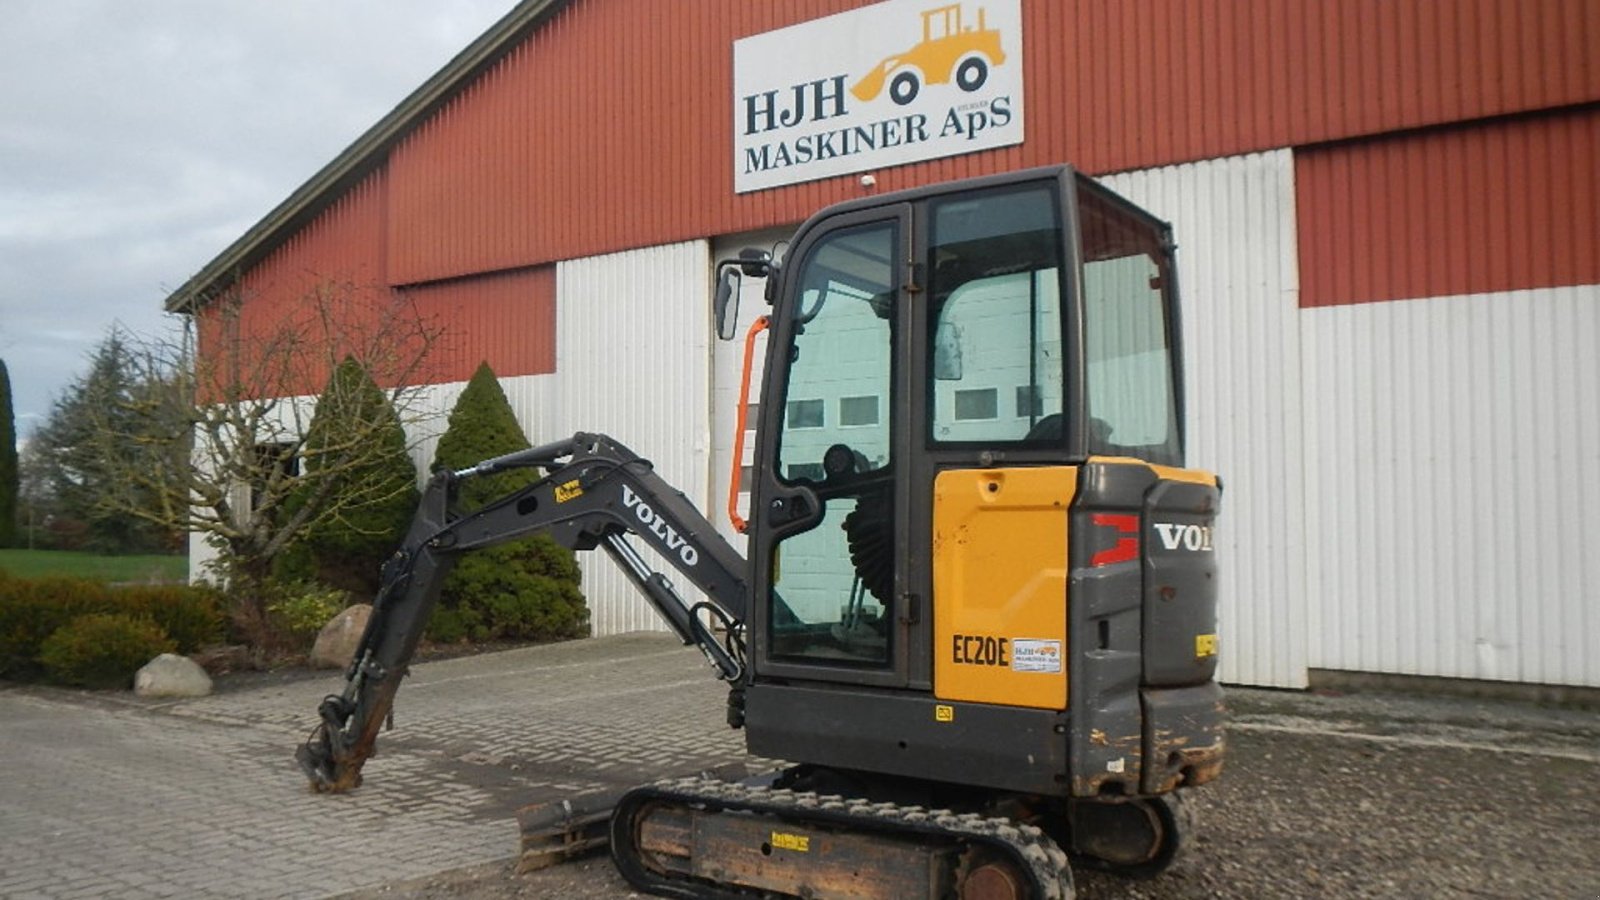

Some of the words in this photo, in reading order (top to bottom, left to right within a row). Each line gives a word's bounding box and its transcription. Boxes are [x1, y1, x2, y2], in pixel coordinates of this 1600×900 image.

[743, 74, 849, 135] HJH
[744, 113, 929, 174] MASKINER
[939, 96, 1011, 140] ApS
[622, 484, 698, 566] VOLVO
[953, 634, 1008, 666] EC20E
